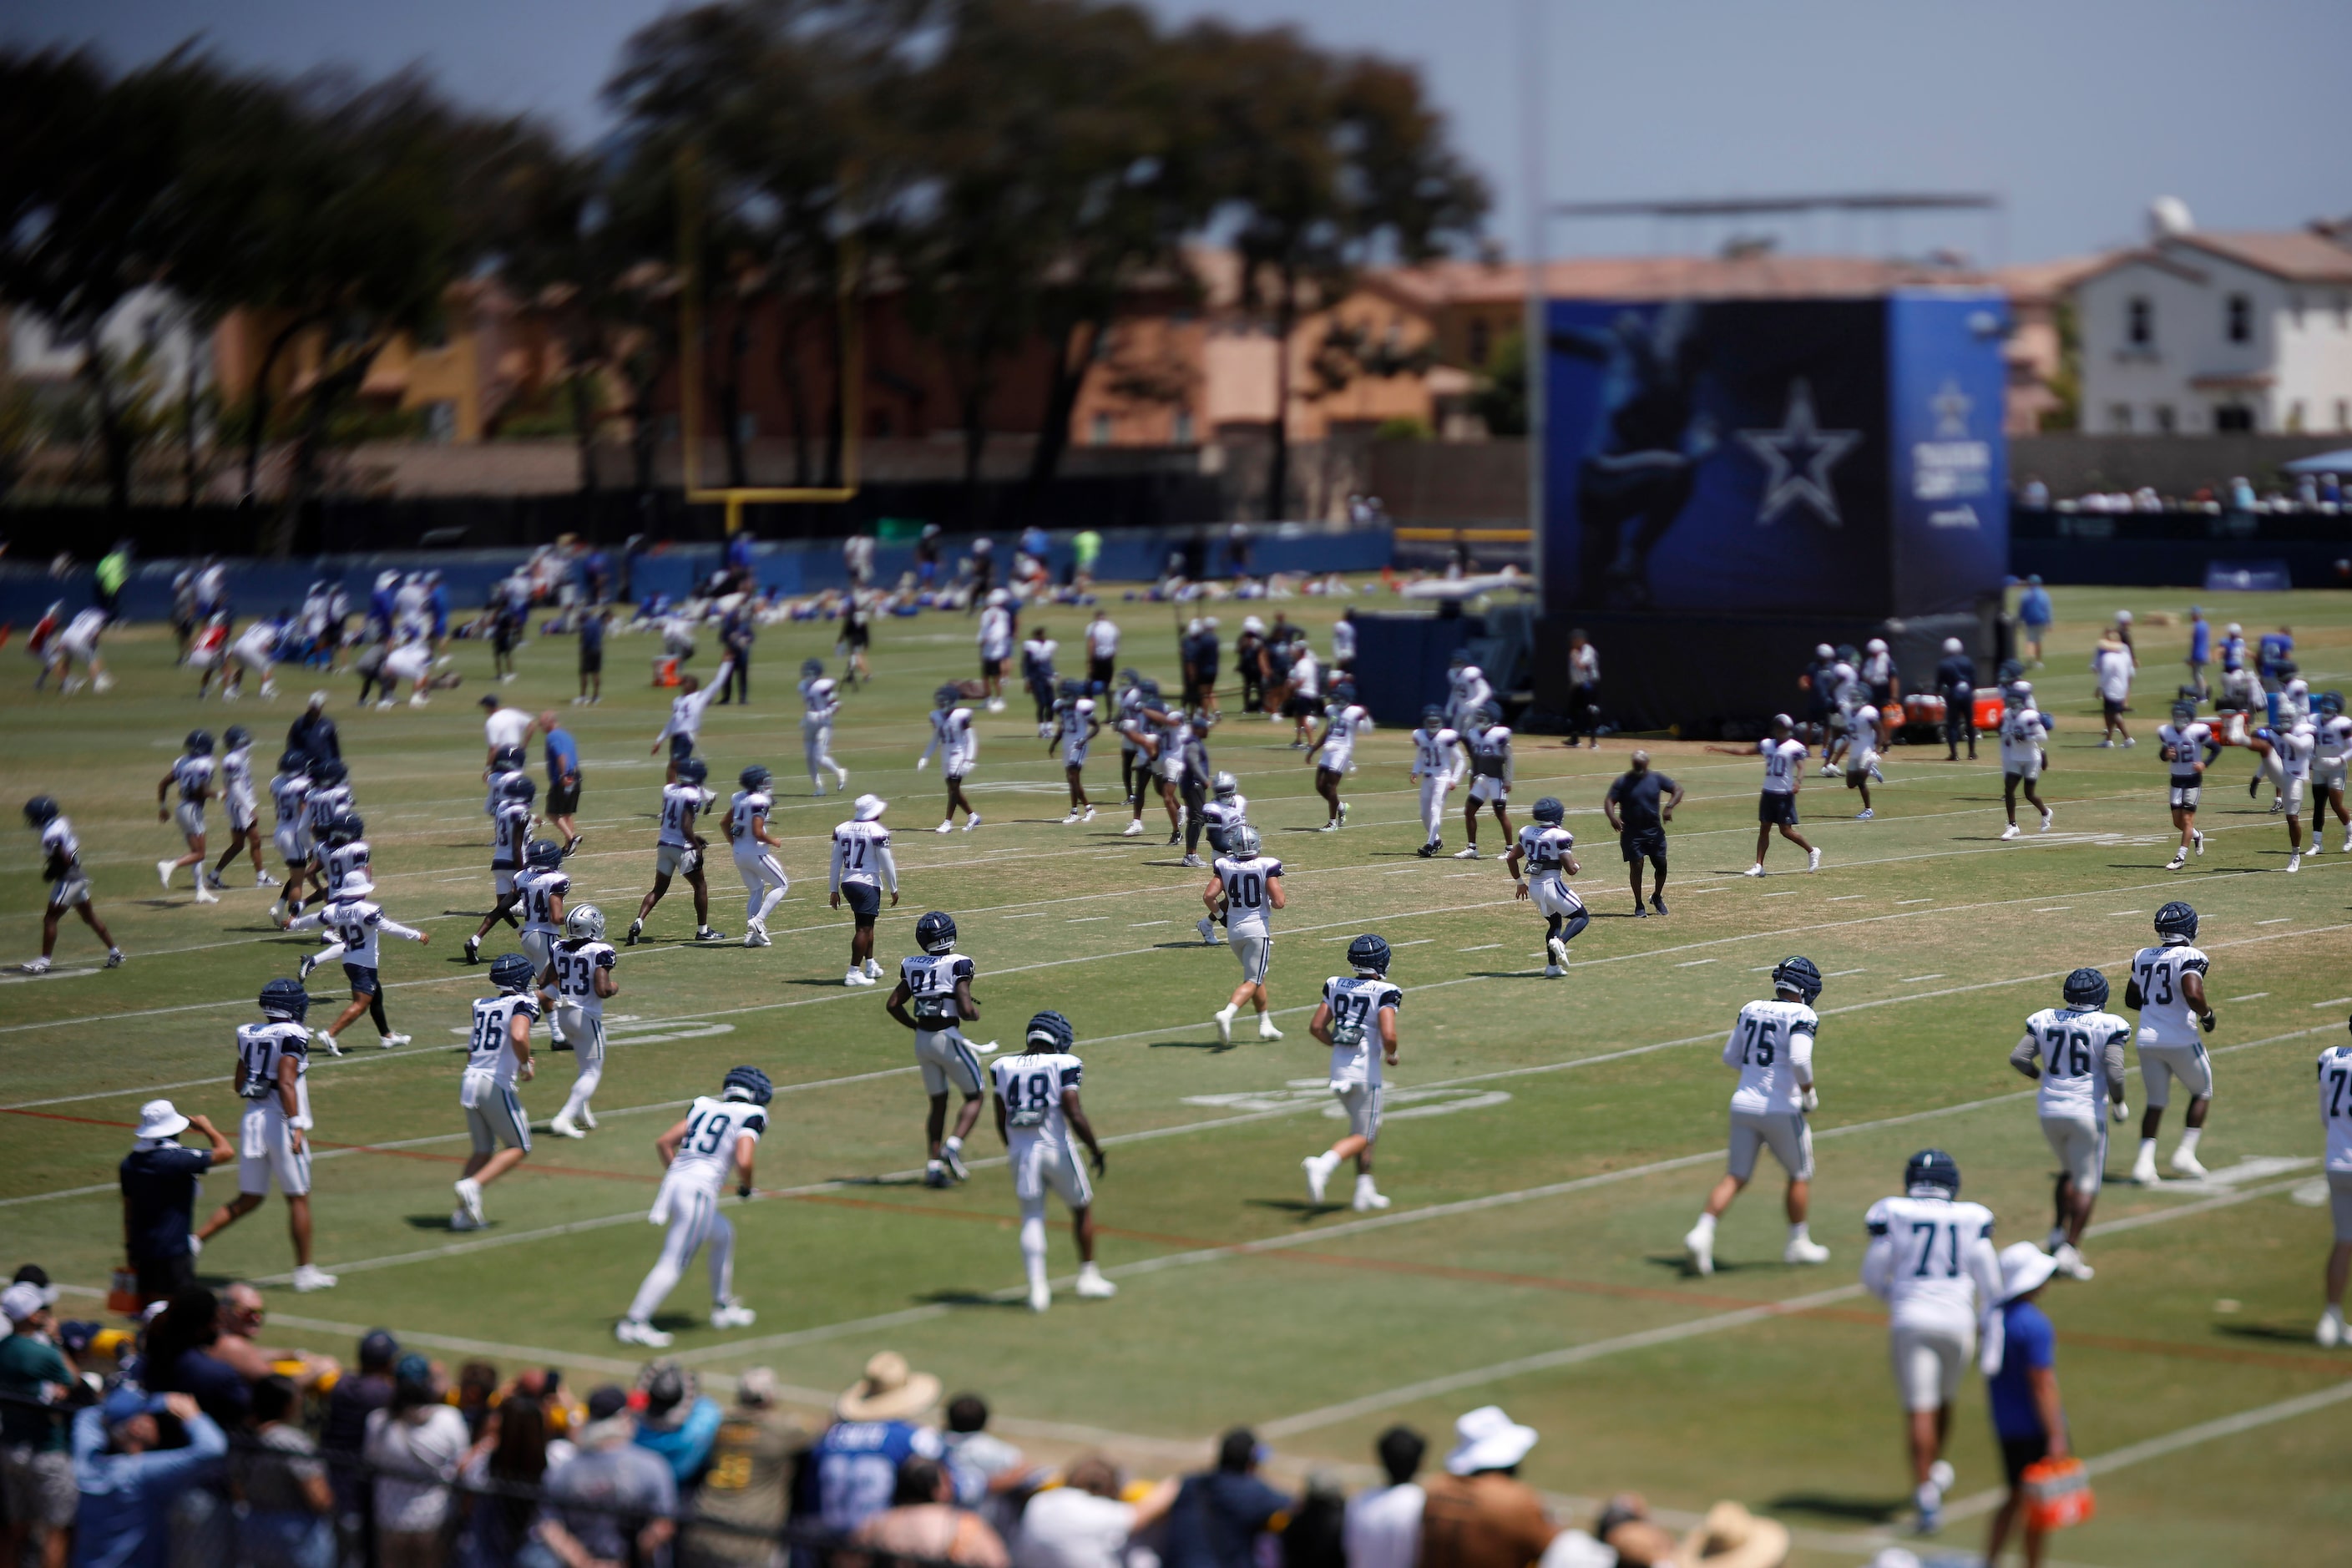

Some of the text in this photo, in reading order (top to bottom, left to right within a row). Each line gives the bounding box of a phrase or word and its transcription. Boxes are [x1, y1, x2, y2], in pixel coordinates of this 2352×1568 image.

[842, 837, 866, 869] 27
[1525, 839, 1551, 862] 36
[1228, 873, 1262, 908] 40
[339, 924, 366, 953] 42
[558, 957, 589, 996] 23
[911, 969, 937, 994] 81
[2140, 963, 2173, 1006] 73
[1333, 994, 1370, 1027] 87
[1743, 1018, 1777, 1067] 75
[2046, 1029, 2092, 1076] 76
[1008, 1074, 1049, 1111] 48
[2330, 1068, 2352, 1117] 7
[1913, 1222, 1958, 1277] 71
